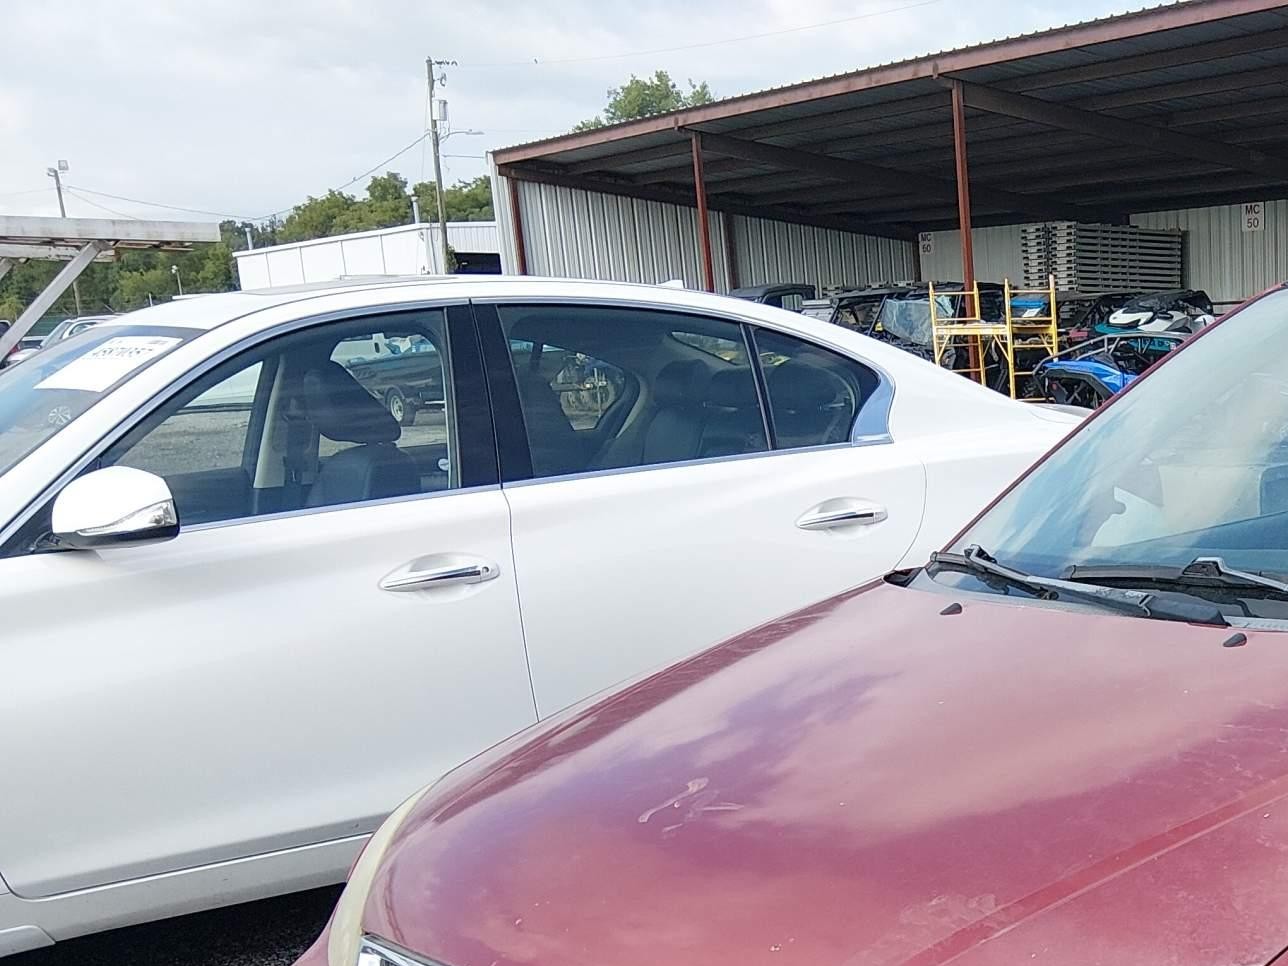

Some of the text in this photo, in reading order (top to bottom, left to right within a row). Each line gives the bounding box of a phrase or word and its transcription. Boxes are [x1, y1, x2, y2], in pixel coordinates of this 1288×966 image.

[1245, 204, 1260, 215] MC
[1247, 217, 1259, 229] 50
[920, 233, 932, 242] MC
